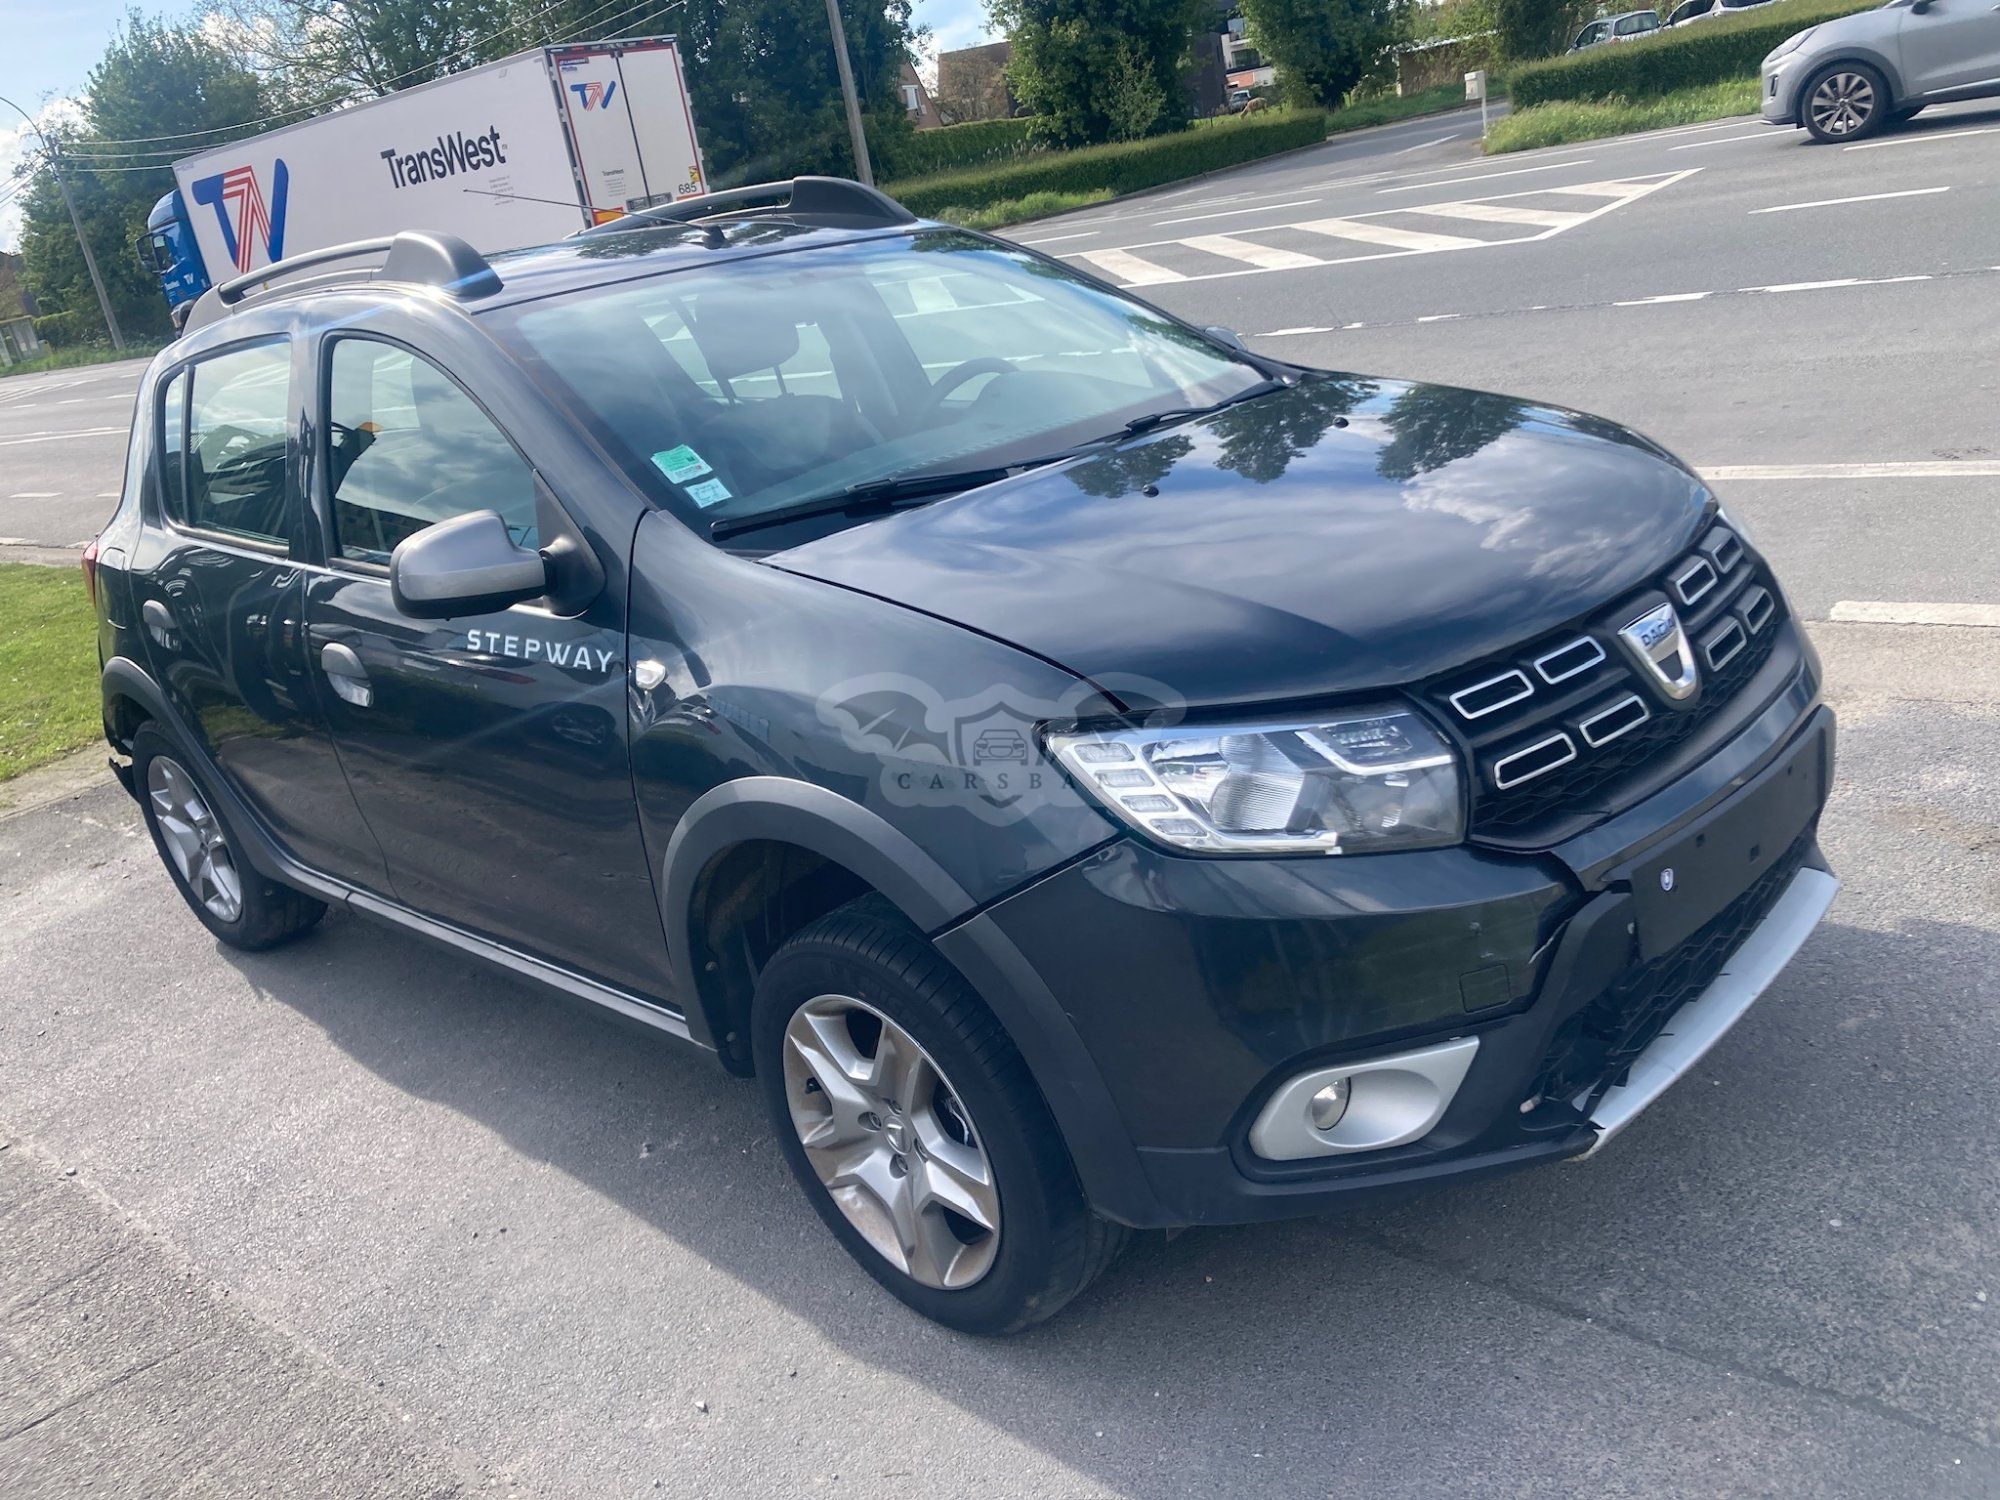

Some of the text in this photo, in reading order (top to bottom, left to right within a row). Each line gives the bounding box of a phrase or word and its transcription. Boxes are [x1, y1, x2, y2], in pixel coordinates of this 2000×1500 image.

[380, 125, 506, 188] TransWest
[678, 182, 697, 194] 685
[466, 628, 614, 673] STEPWAY
